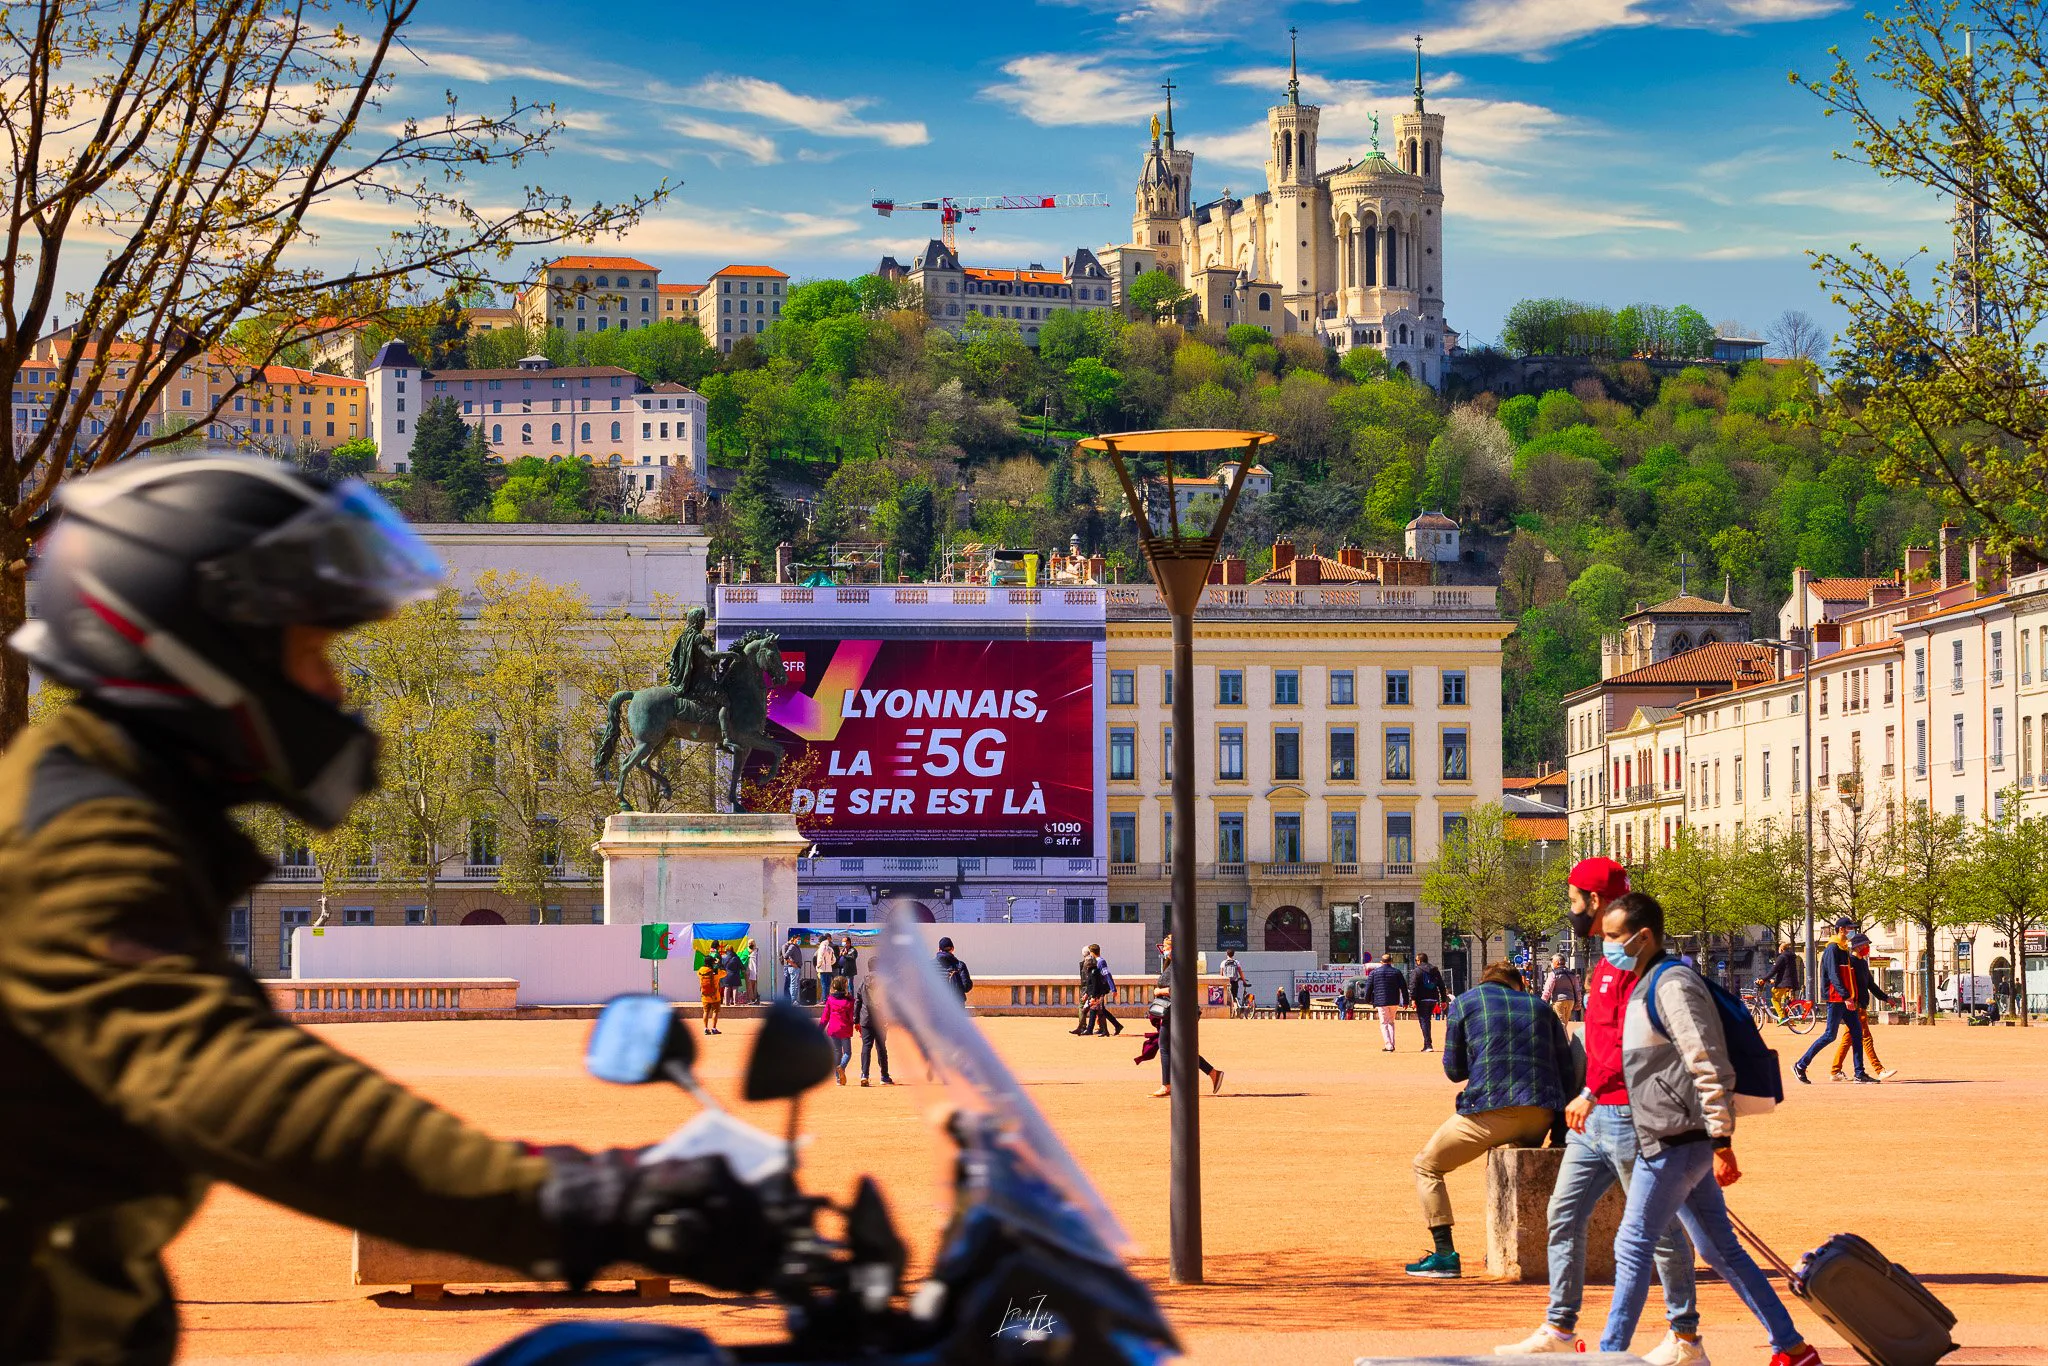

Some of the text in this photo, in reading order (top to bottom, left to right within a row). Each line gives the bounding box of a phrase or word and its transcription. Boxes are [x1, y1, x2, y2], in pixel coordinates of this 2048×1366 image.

[782, 661, 805, 672] SFR
[841, 689, 1049, 723] LYONNAIS,
[828, 728, 1008, 777] LA 5G
[790, 781, 1047, 815] DE SFR EST LÀ
[1051, 822, 1082, 833] 1090
[1056, 836, 1081, 846] sfr.fr
